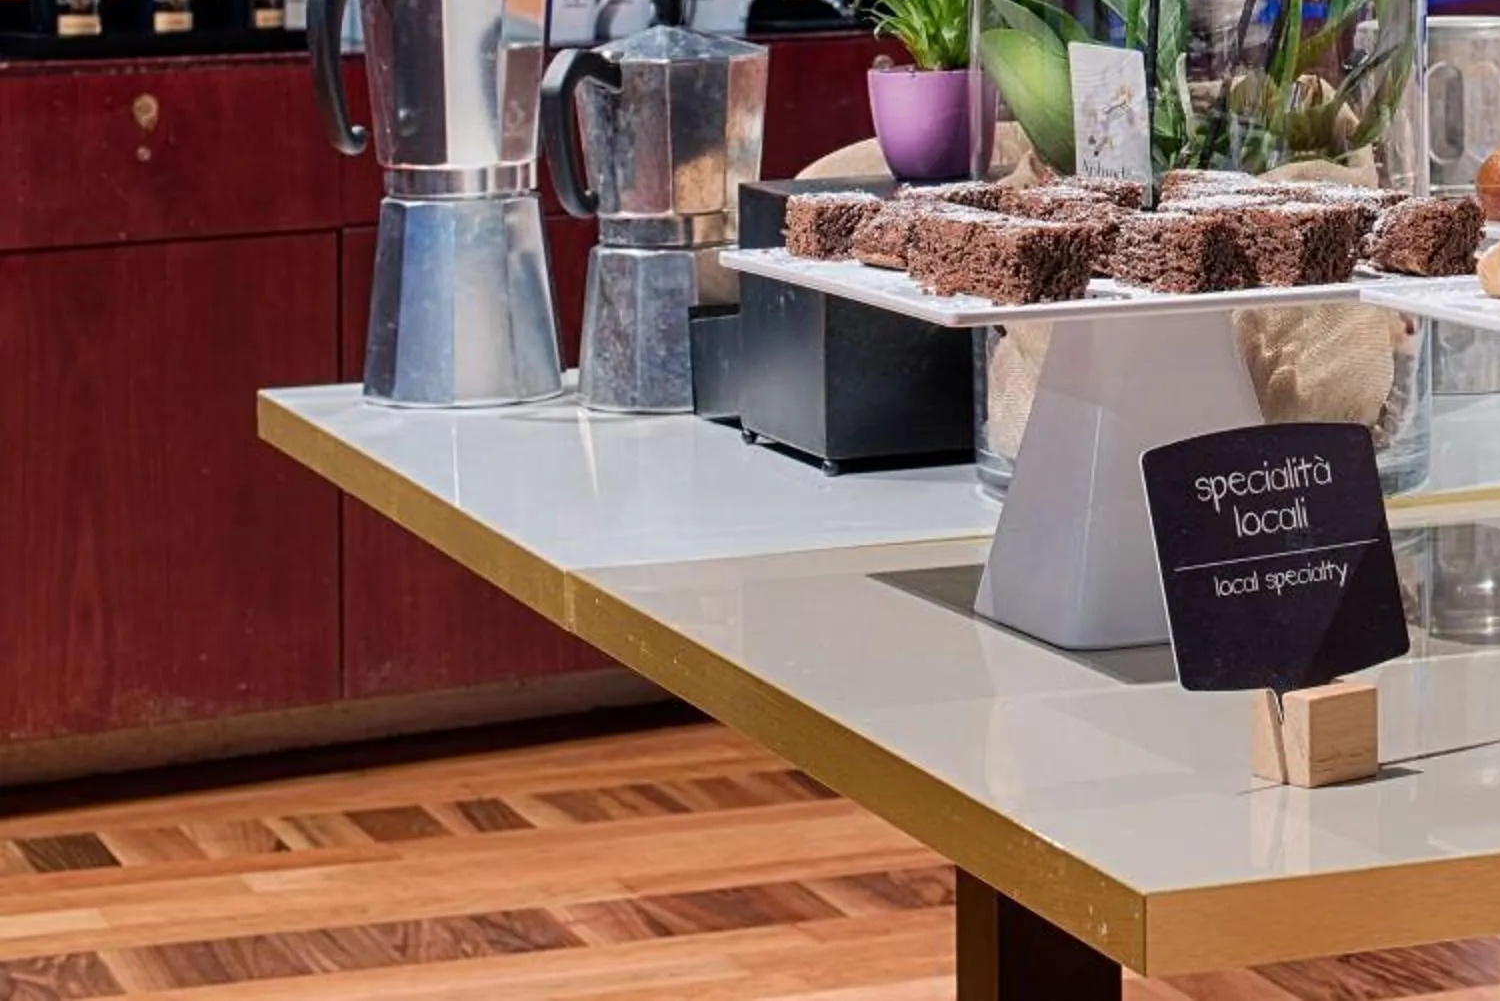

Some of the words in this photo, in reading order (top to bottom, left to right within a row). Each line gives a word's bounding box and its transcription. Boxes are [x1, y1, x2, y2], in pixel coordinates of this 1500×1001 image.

[1195, 455, 1332, 514] specialità
[1234, 497, 1309, 537] locali
[1213, 570, 1259, 597] local
[1265, 560, 1348, 596] specialty
